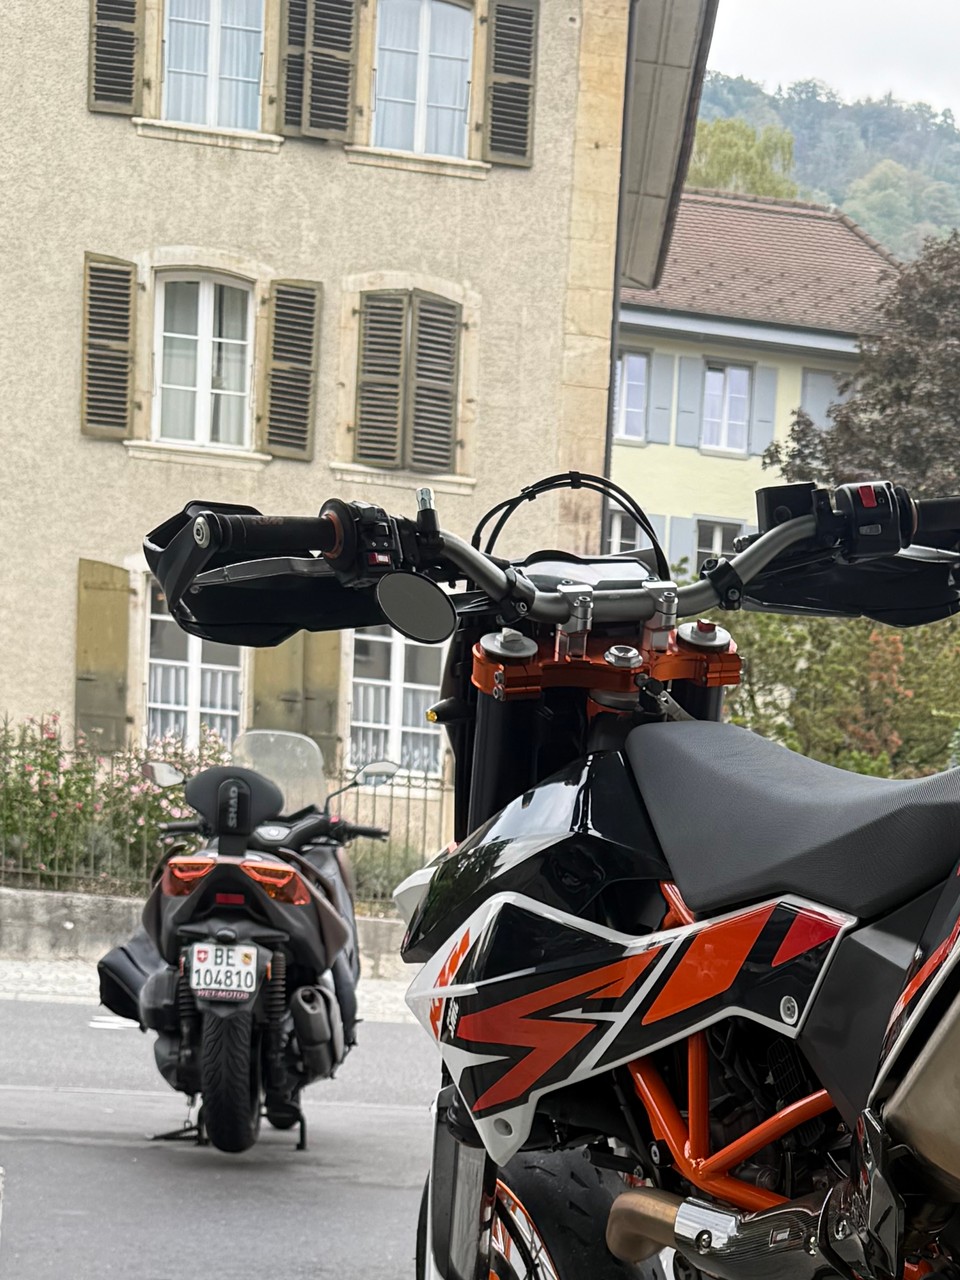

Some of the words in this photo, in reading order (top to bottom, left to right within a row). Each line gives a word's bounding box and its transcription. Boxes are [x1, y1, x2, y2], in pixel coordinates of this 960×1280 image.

[228, 786, 239, 827] SHAD
[214, 948, 236, 967] BE
[194, 968, 254, 989] 104810
[196, 989, 250, 1000] WET-MOTOS
